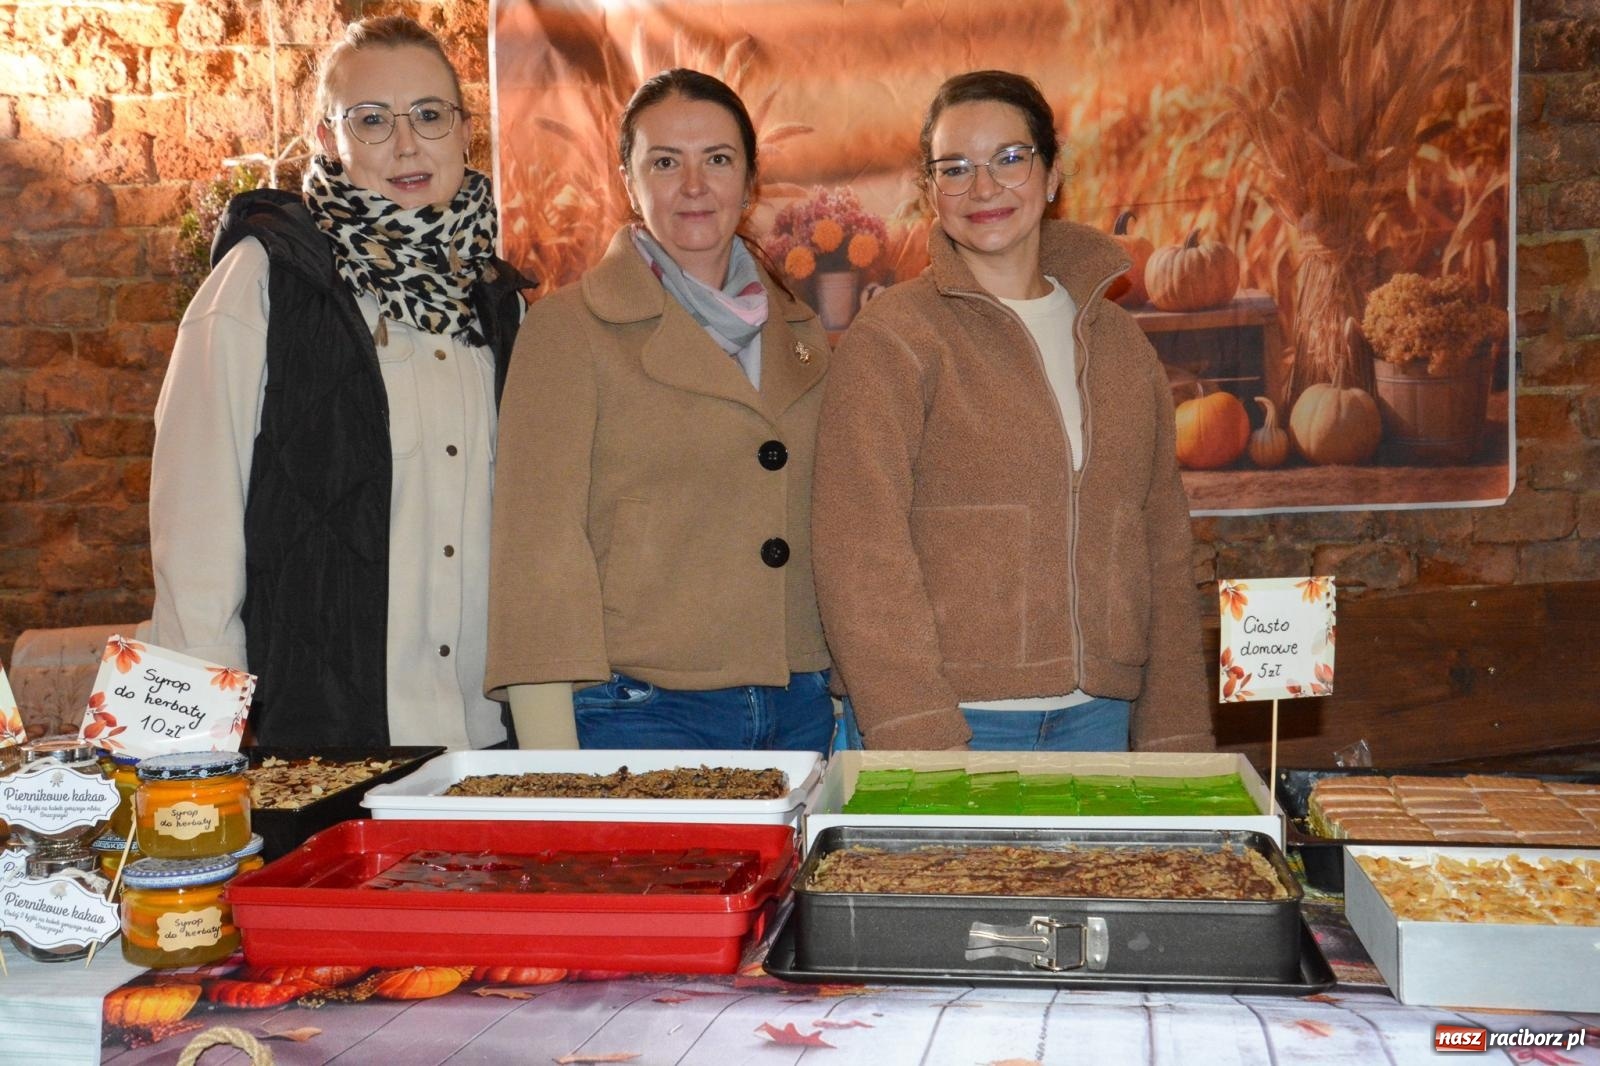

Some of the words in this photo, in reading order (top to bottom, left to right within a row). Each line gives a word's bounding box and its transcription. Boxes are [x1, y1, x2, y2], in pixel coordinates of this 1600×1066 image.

[1243, 615, 1290, 634] Ciasto
[1240, 641, 1299, 656] domowe
[143, 668, 191, 693] Syrop
[114, 685, 136, 699] do
[144, 692, 207, 730] herbaty
[3, 787, 70, 801] Piernikowe
[71, 788, 107, 802] kakao
[170, 809, 199, 820] Syrop
[176, 817, 212, 830] herbaty
[4, 891, 70, 917] Piernikowe
[71, 905, 107, 924] kakao
[174, 918, 204, 933] Syrop
[164, 931, 177, 939] do
